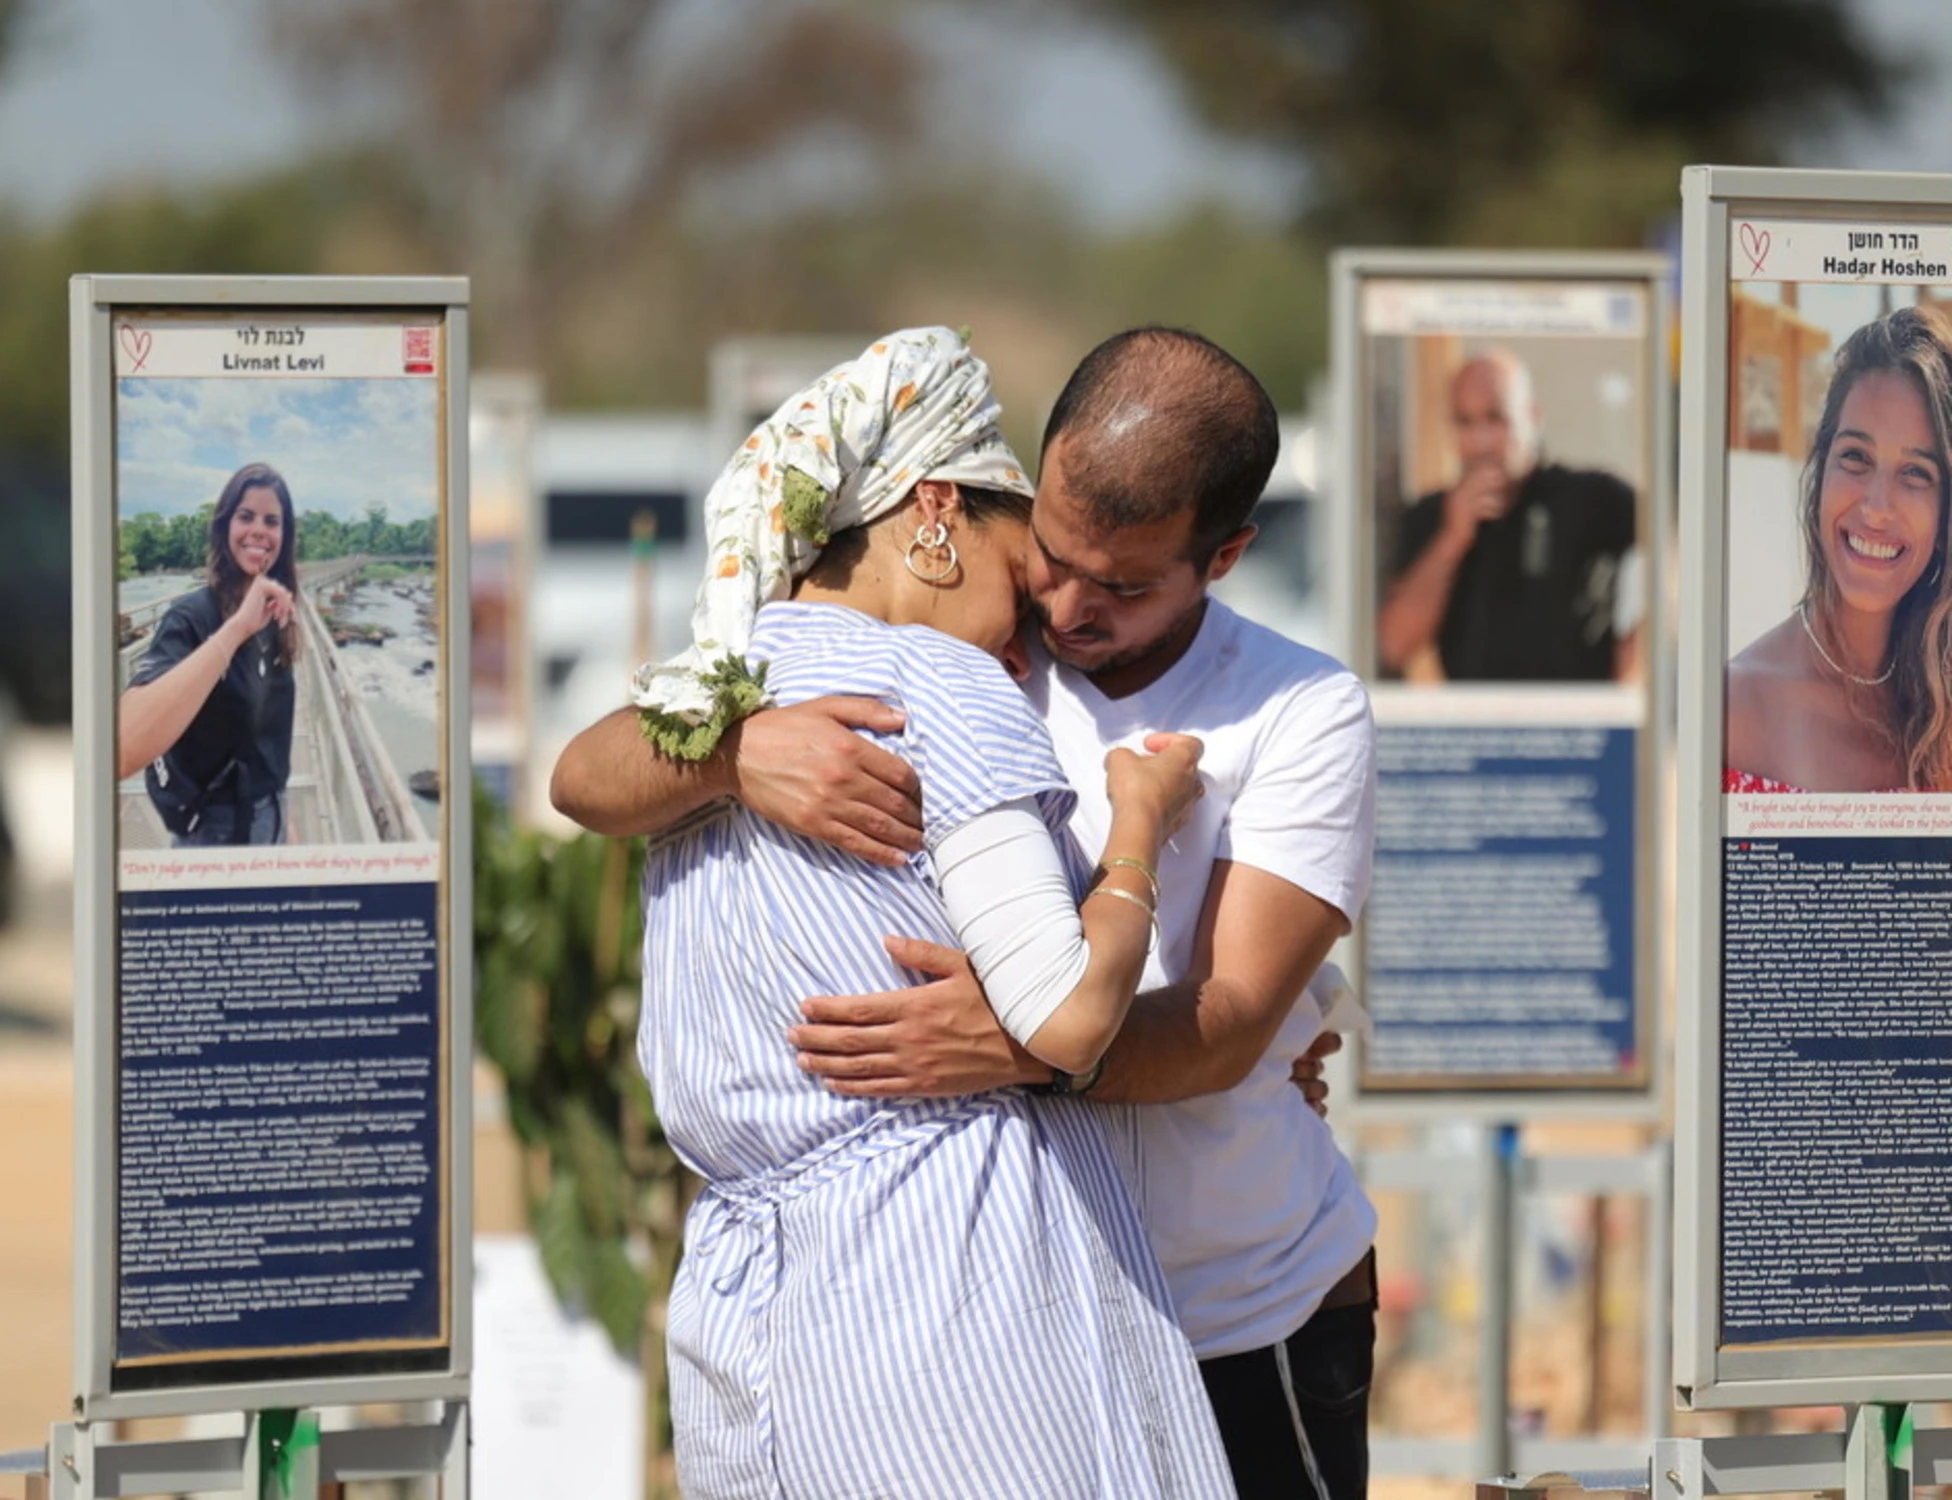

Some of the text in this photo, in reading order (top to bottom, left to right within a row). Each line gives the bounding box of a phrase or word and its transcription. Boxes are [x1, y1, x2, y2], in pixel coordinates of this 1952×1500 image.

[1848, 232, 1919, 252] הדר חושן
[1823, 257, 1947, 276] Hadar Hoshen
[237, 325, 305, 346] לבנת לוי
[223, 354, 324, 371] Livnat Levi
